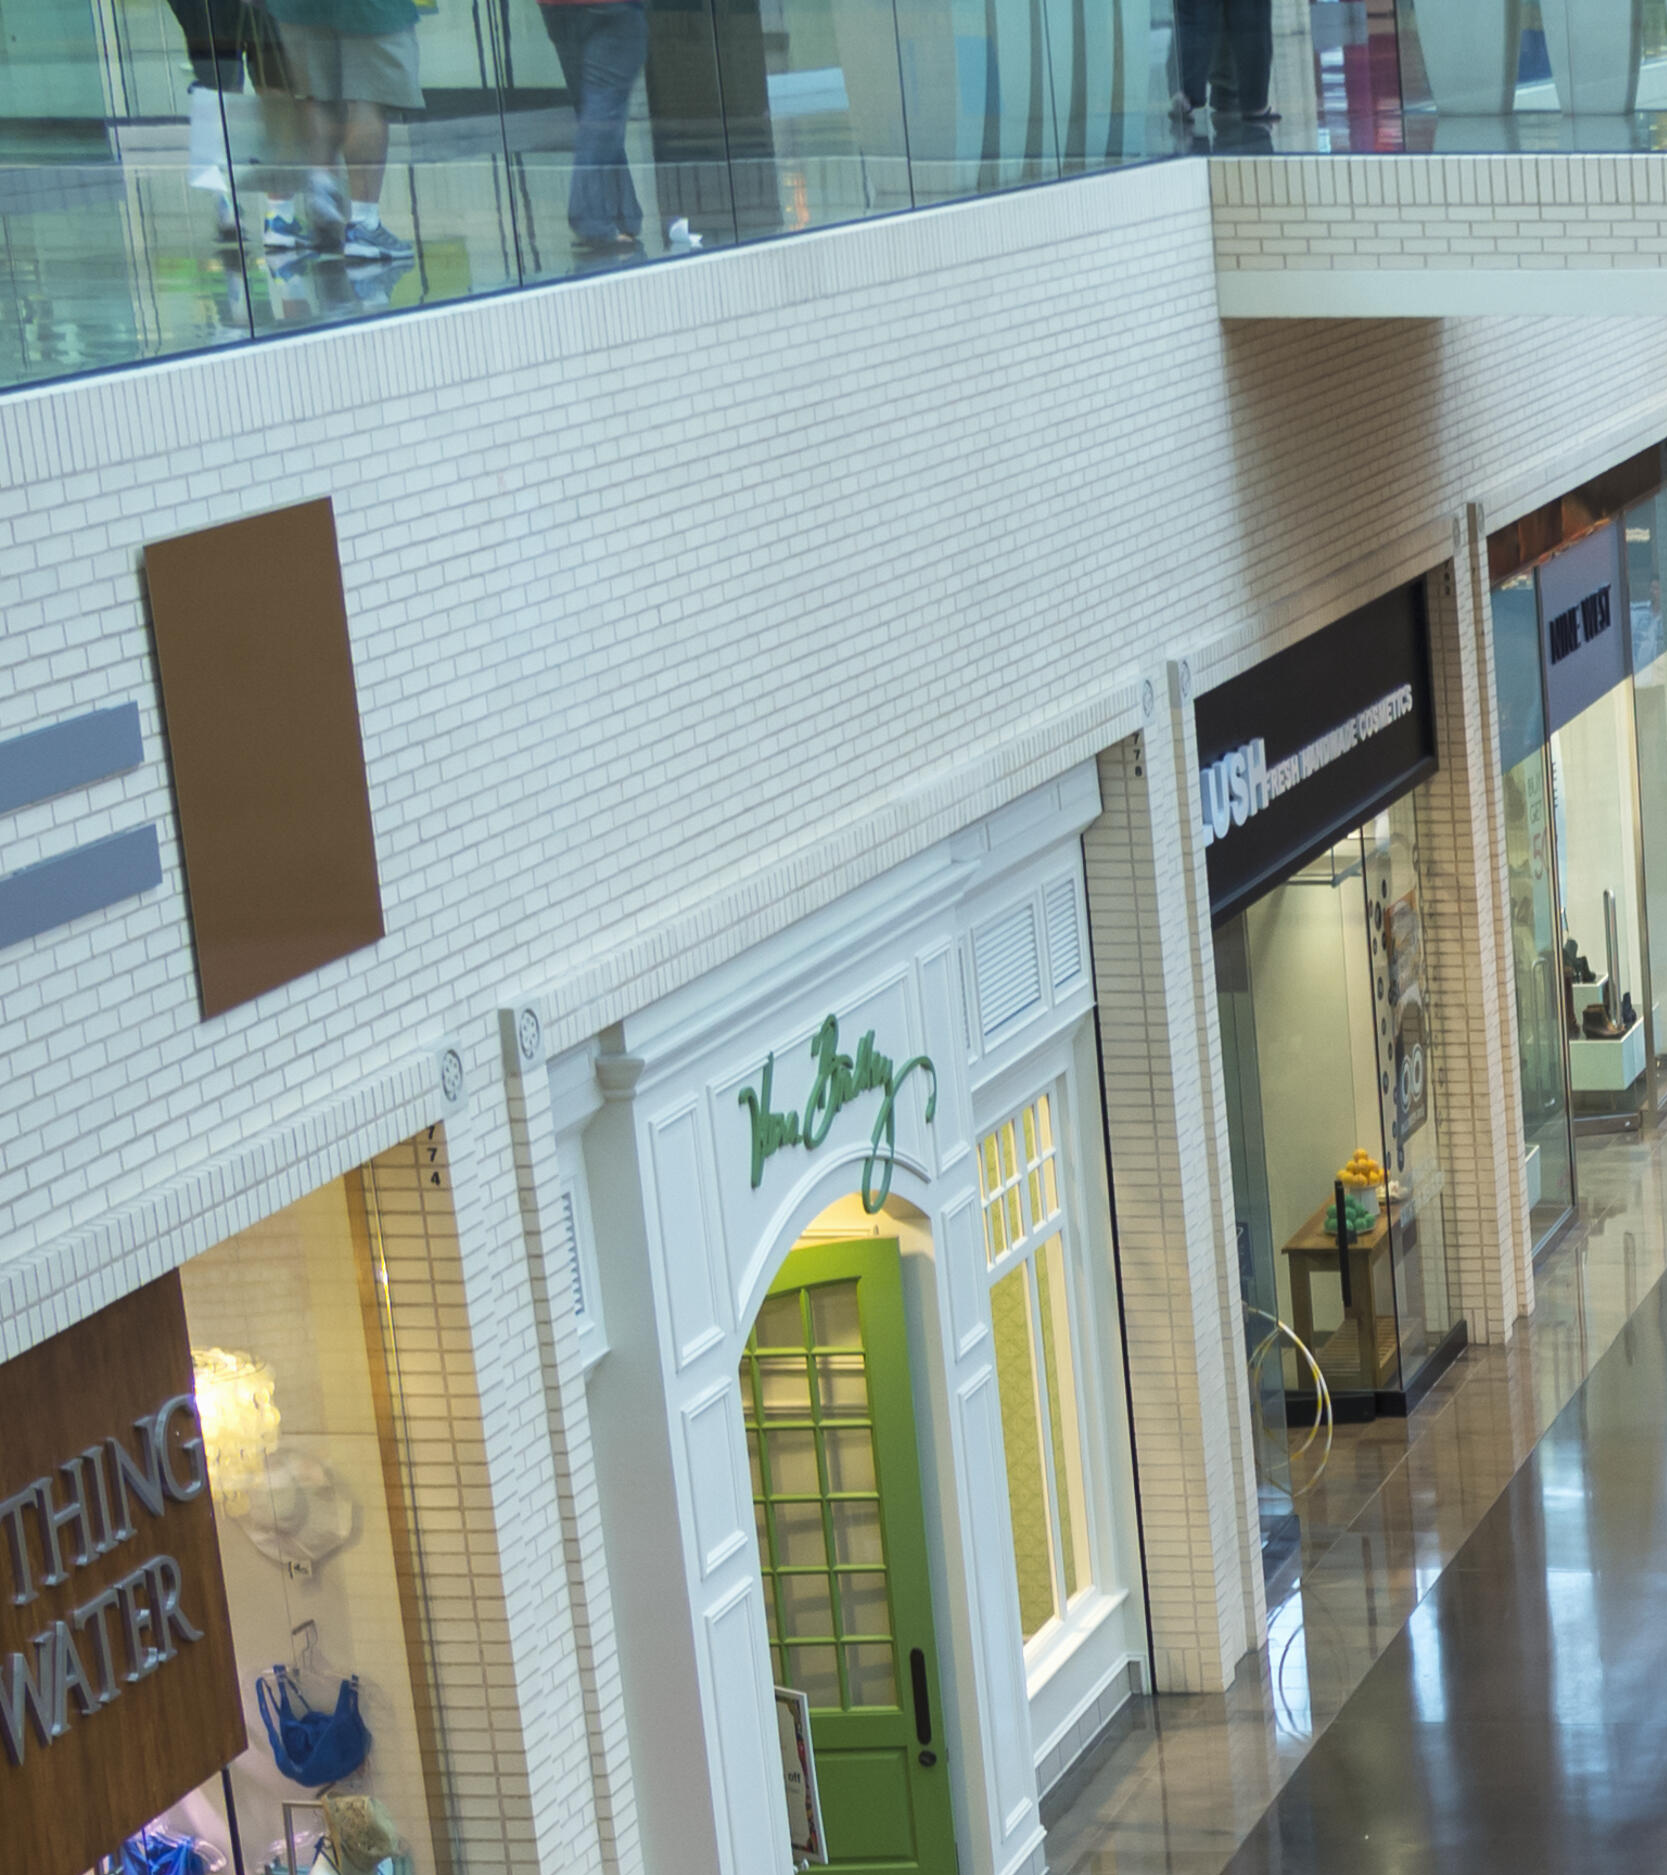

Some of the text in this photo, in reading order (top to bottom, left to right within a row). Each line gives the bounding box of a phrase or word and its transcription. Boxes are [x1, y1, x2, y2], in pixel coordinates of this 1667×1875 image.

[1549, 583, 1611, 666] NINE WEST
[1200, 737, 1269, 849] LUSH
[1266, 753, 1301, 800] FRESH
[1356, 683, 1413, 742] COSMETICS
[0, 1553, 204, 1766] WATER
